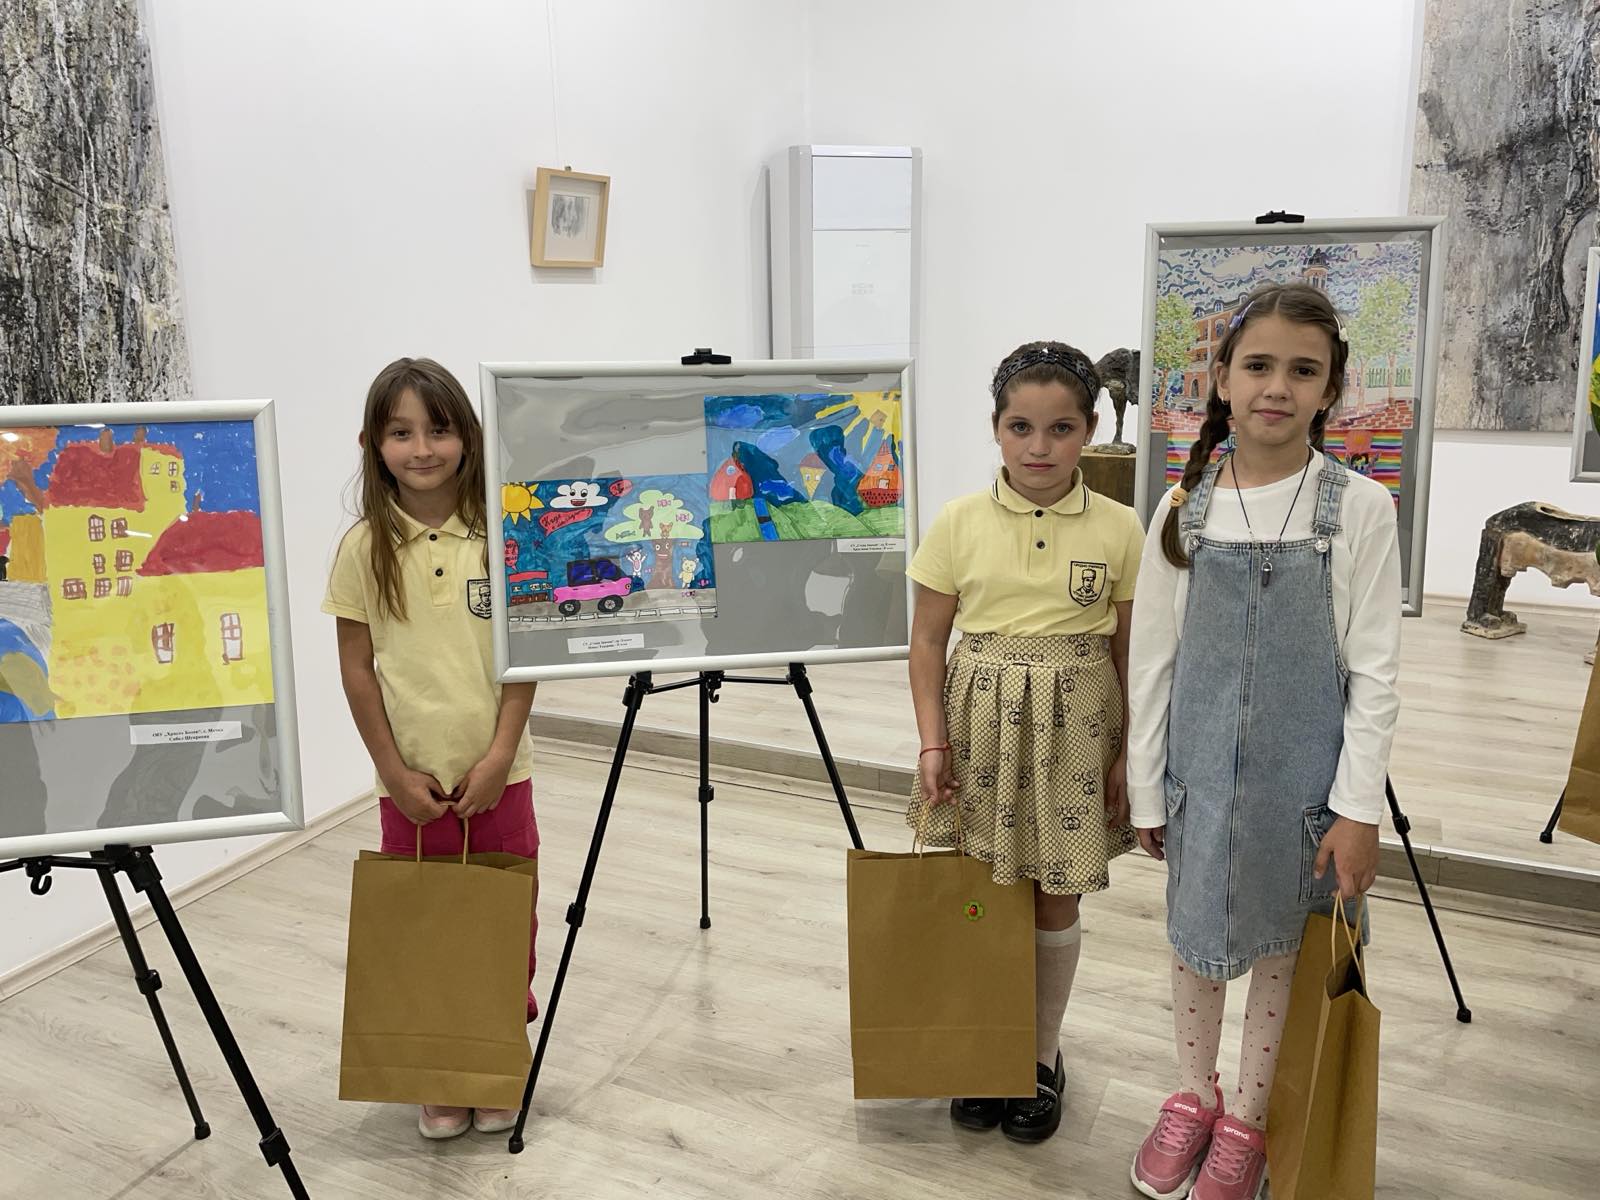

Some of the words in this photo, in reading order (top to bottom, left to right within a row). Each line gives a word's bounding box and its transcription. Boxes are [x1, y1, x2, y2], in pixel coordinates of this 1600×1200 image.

[1004, 652, 1044, 663] GUCCI
[1056, 805, 1089, 817] GUCCI
[1041, 859, 1074, 870] GUCCI
[1223, 1125, 1250, 1140] sprandi
